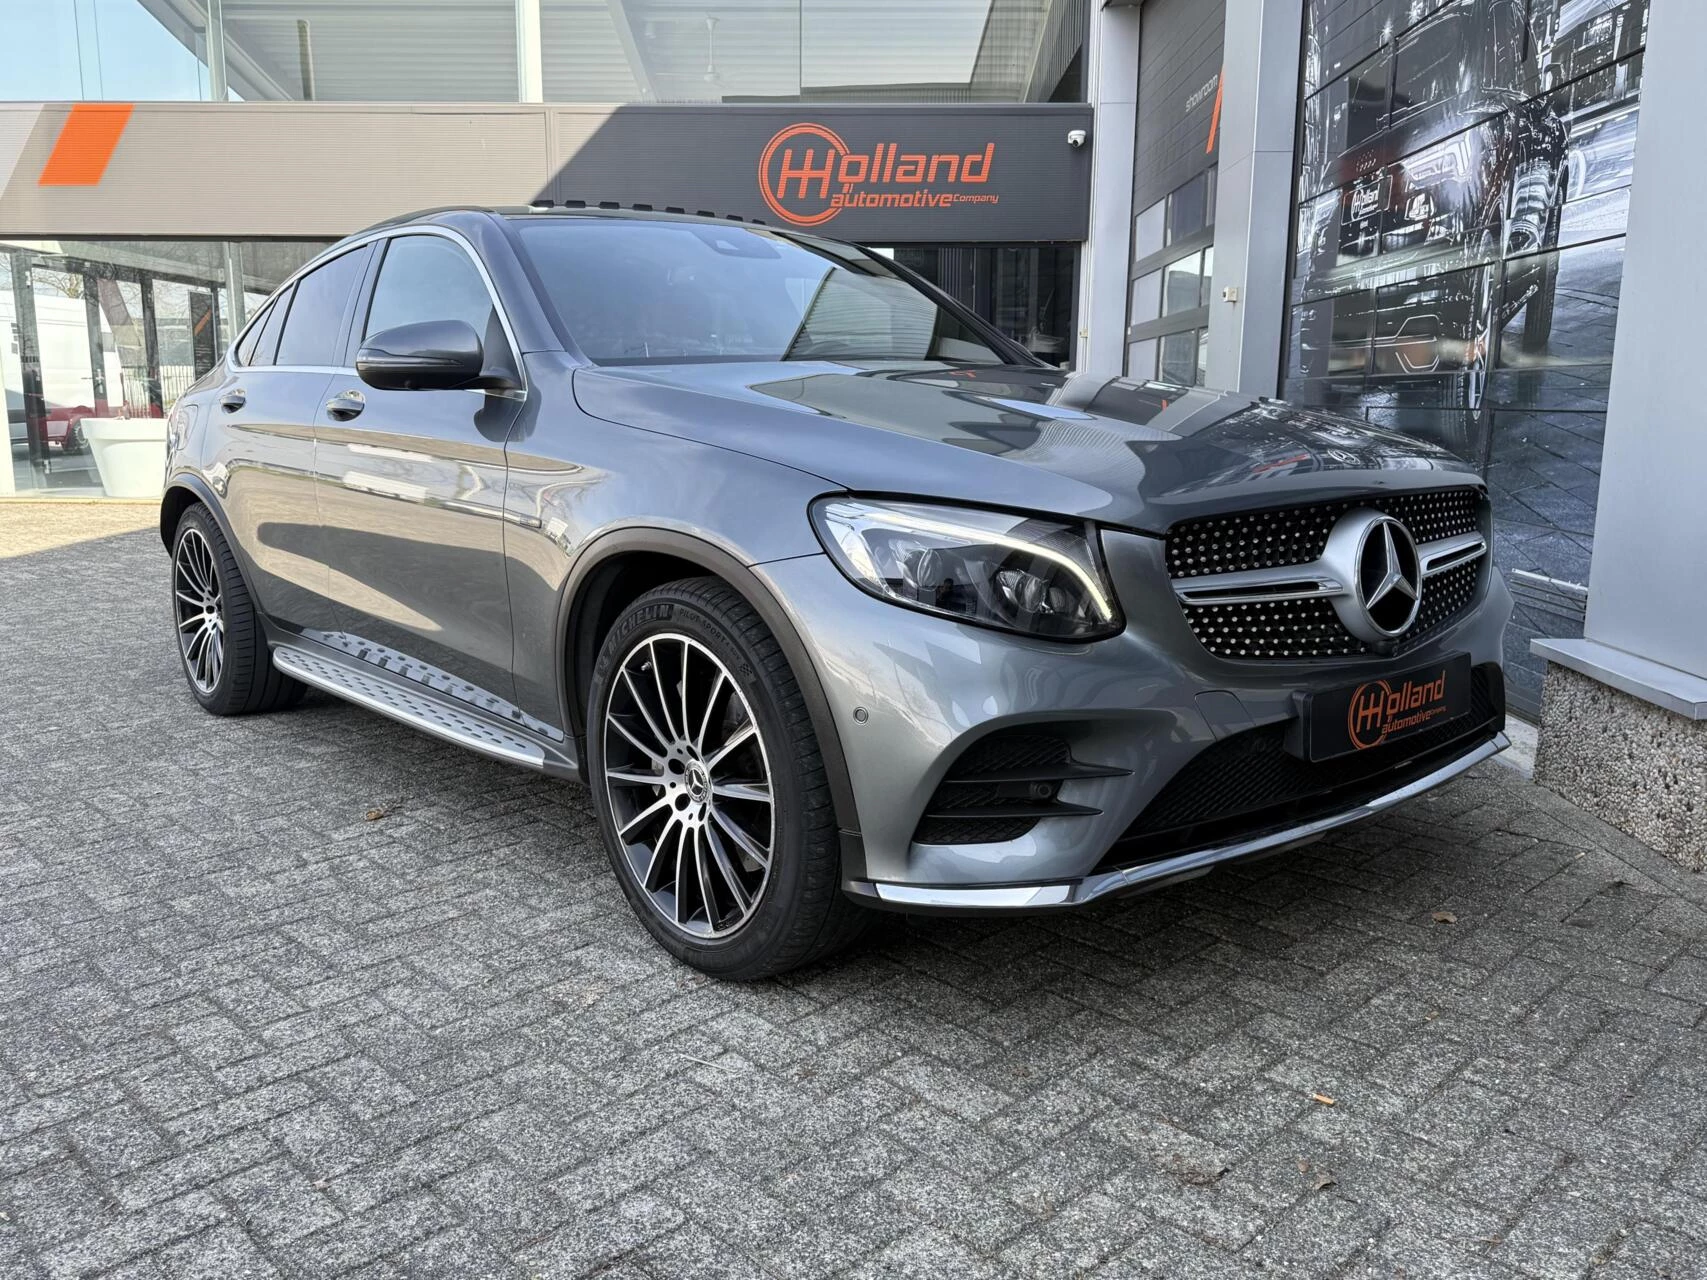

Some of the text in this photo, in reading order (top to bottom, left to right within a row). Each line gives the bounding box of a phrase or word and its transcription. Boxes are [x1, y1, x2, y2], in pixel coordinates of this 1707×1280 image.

[776, 142, 996, 199] Holland
[830, 188, 954, 208] automotive
[607, 604, 671, 655] MICHELIN
[1355, 669, 1446, 734] Holland
